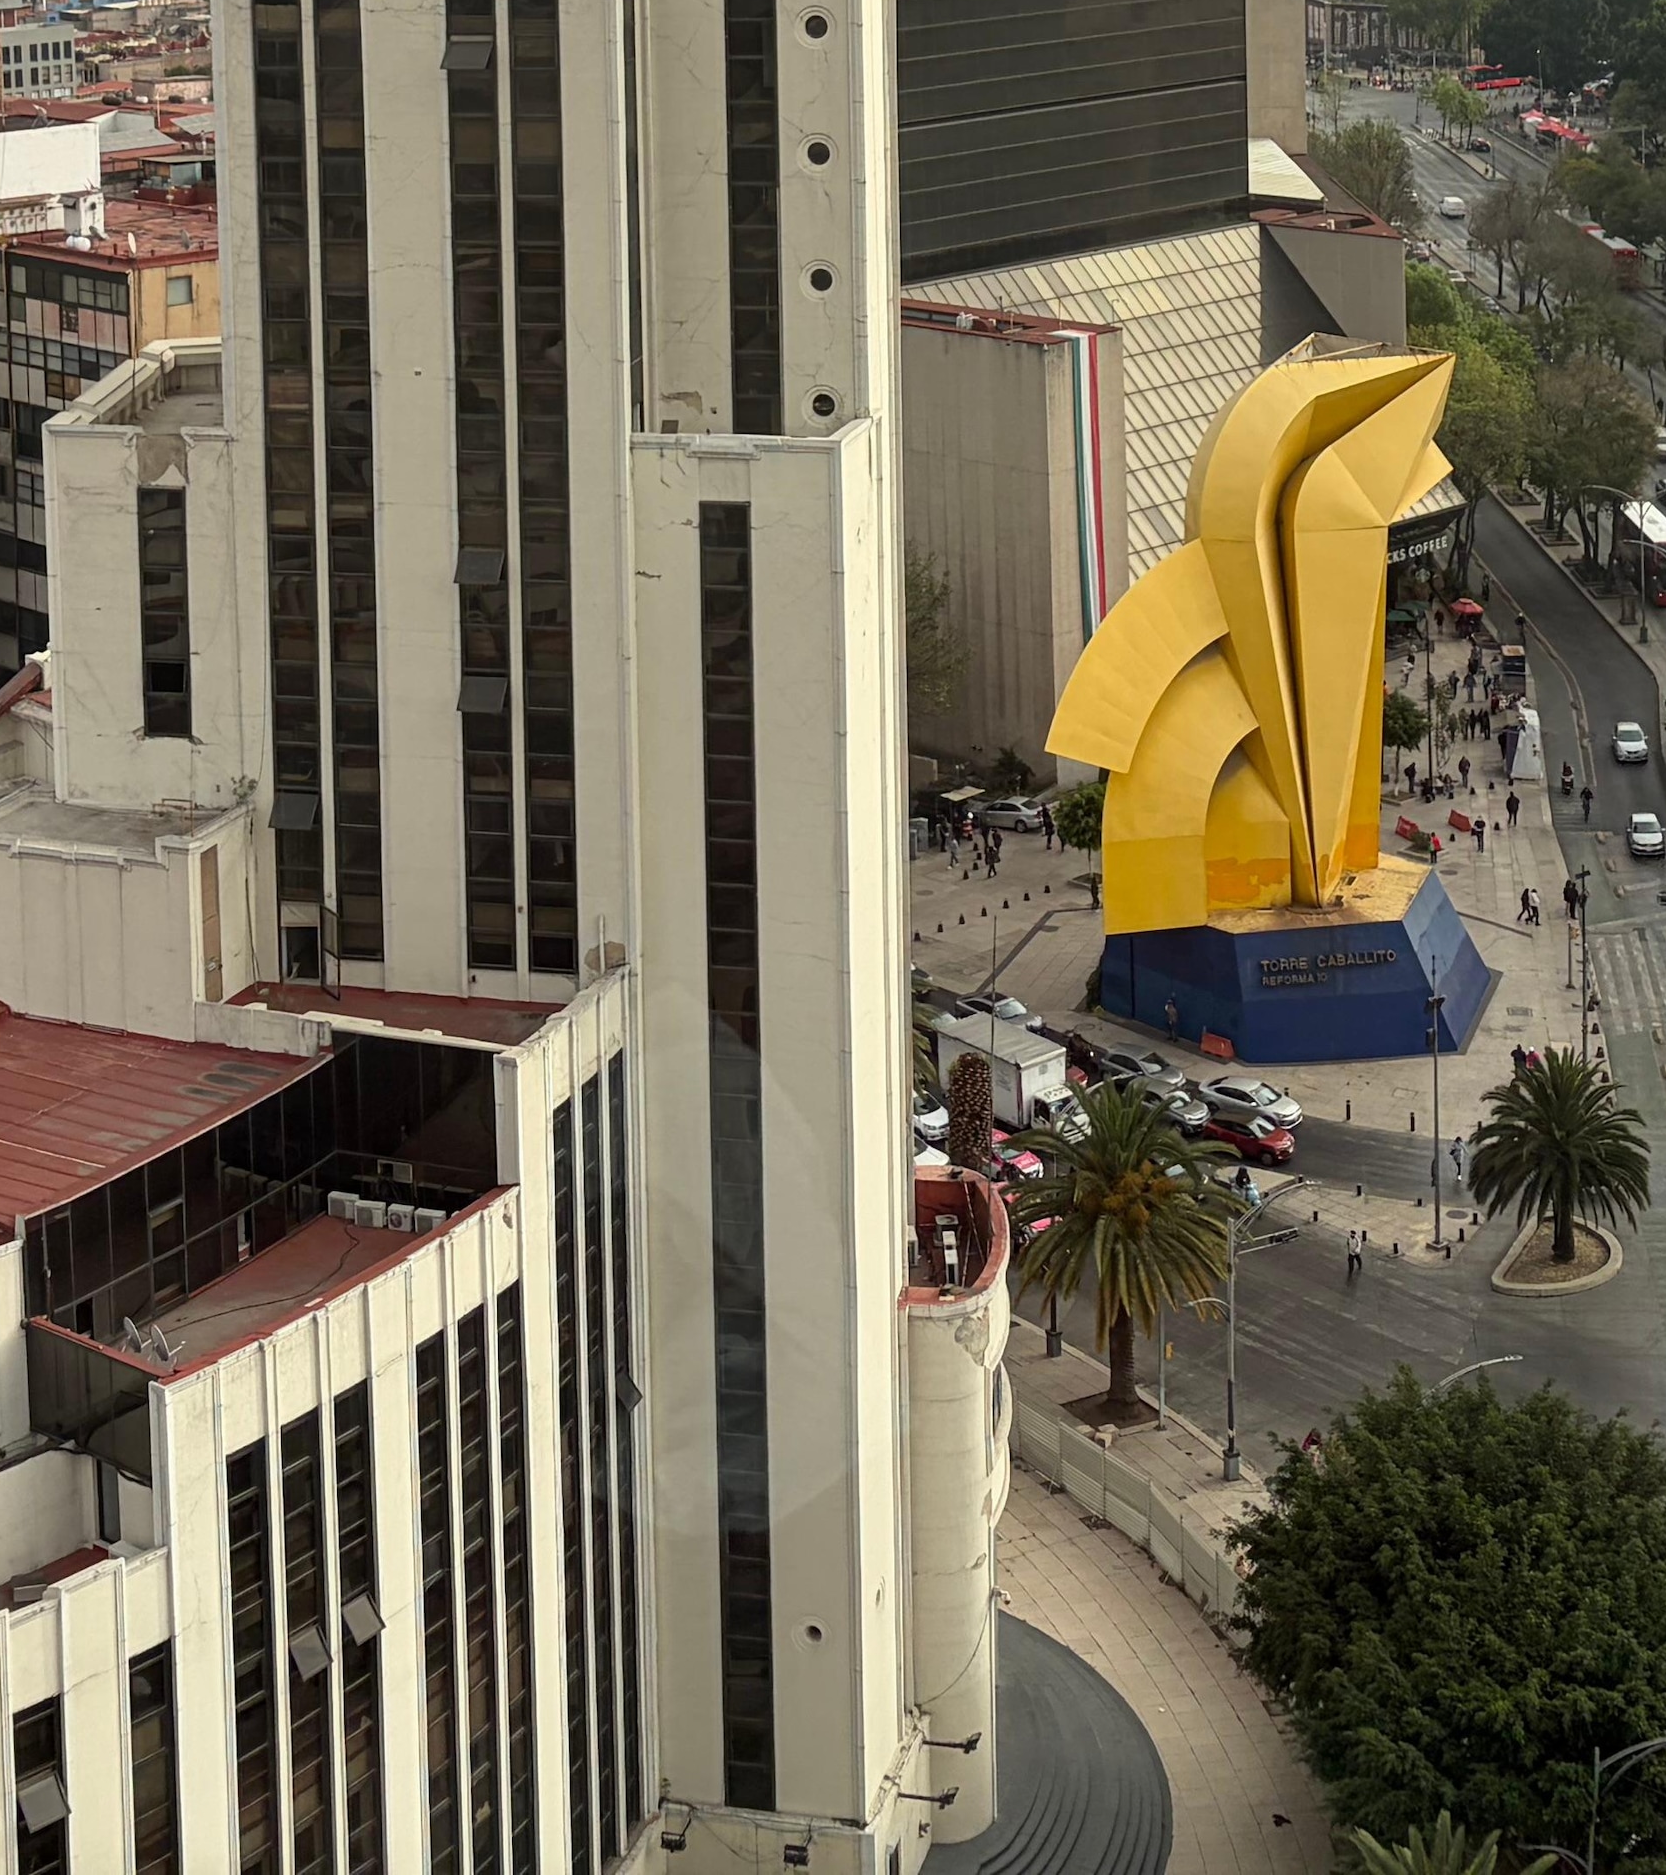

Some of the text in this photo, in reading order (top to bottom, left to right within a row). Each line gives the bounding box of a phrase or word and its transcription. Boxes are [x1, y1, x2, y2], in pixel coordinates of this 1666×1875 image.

[1408, 535, 1448, 558] COFFEE
[1261, 949, 1397, 972] TORRE CABALLITO
[1262, 973, 1315, 986] REFORMA
